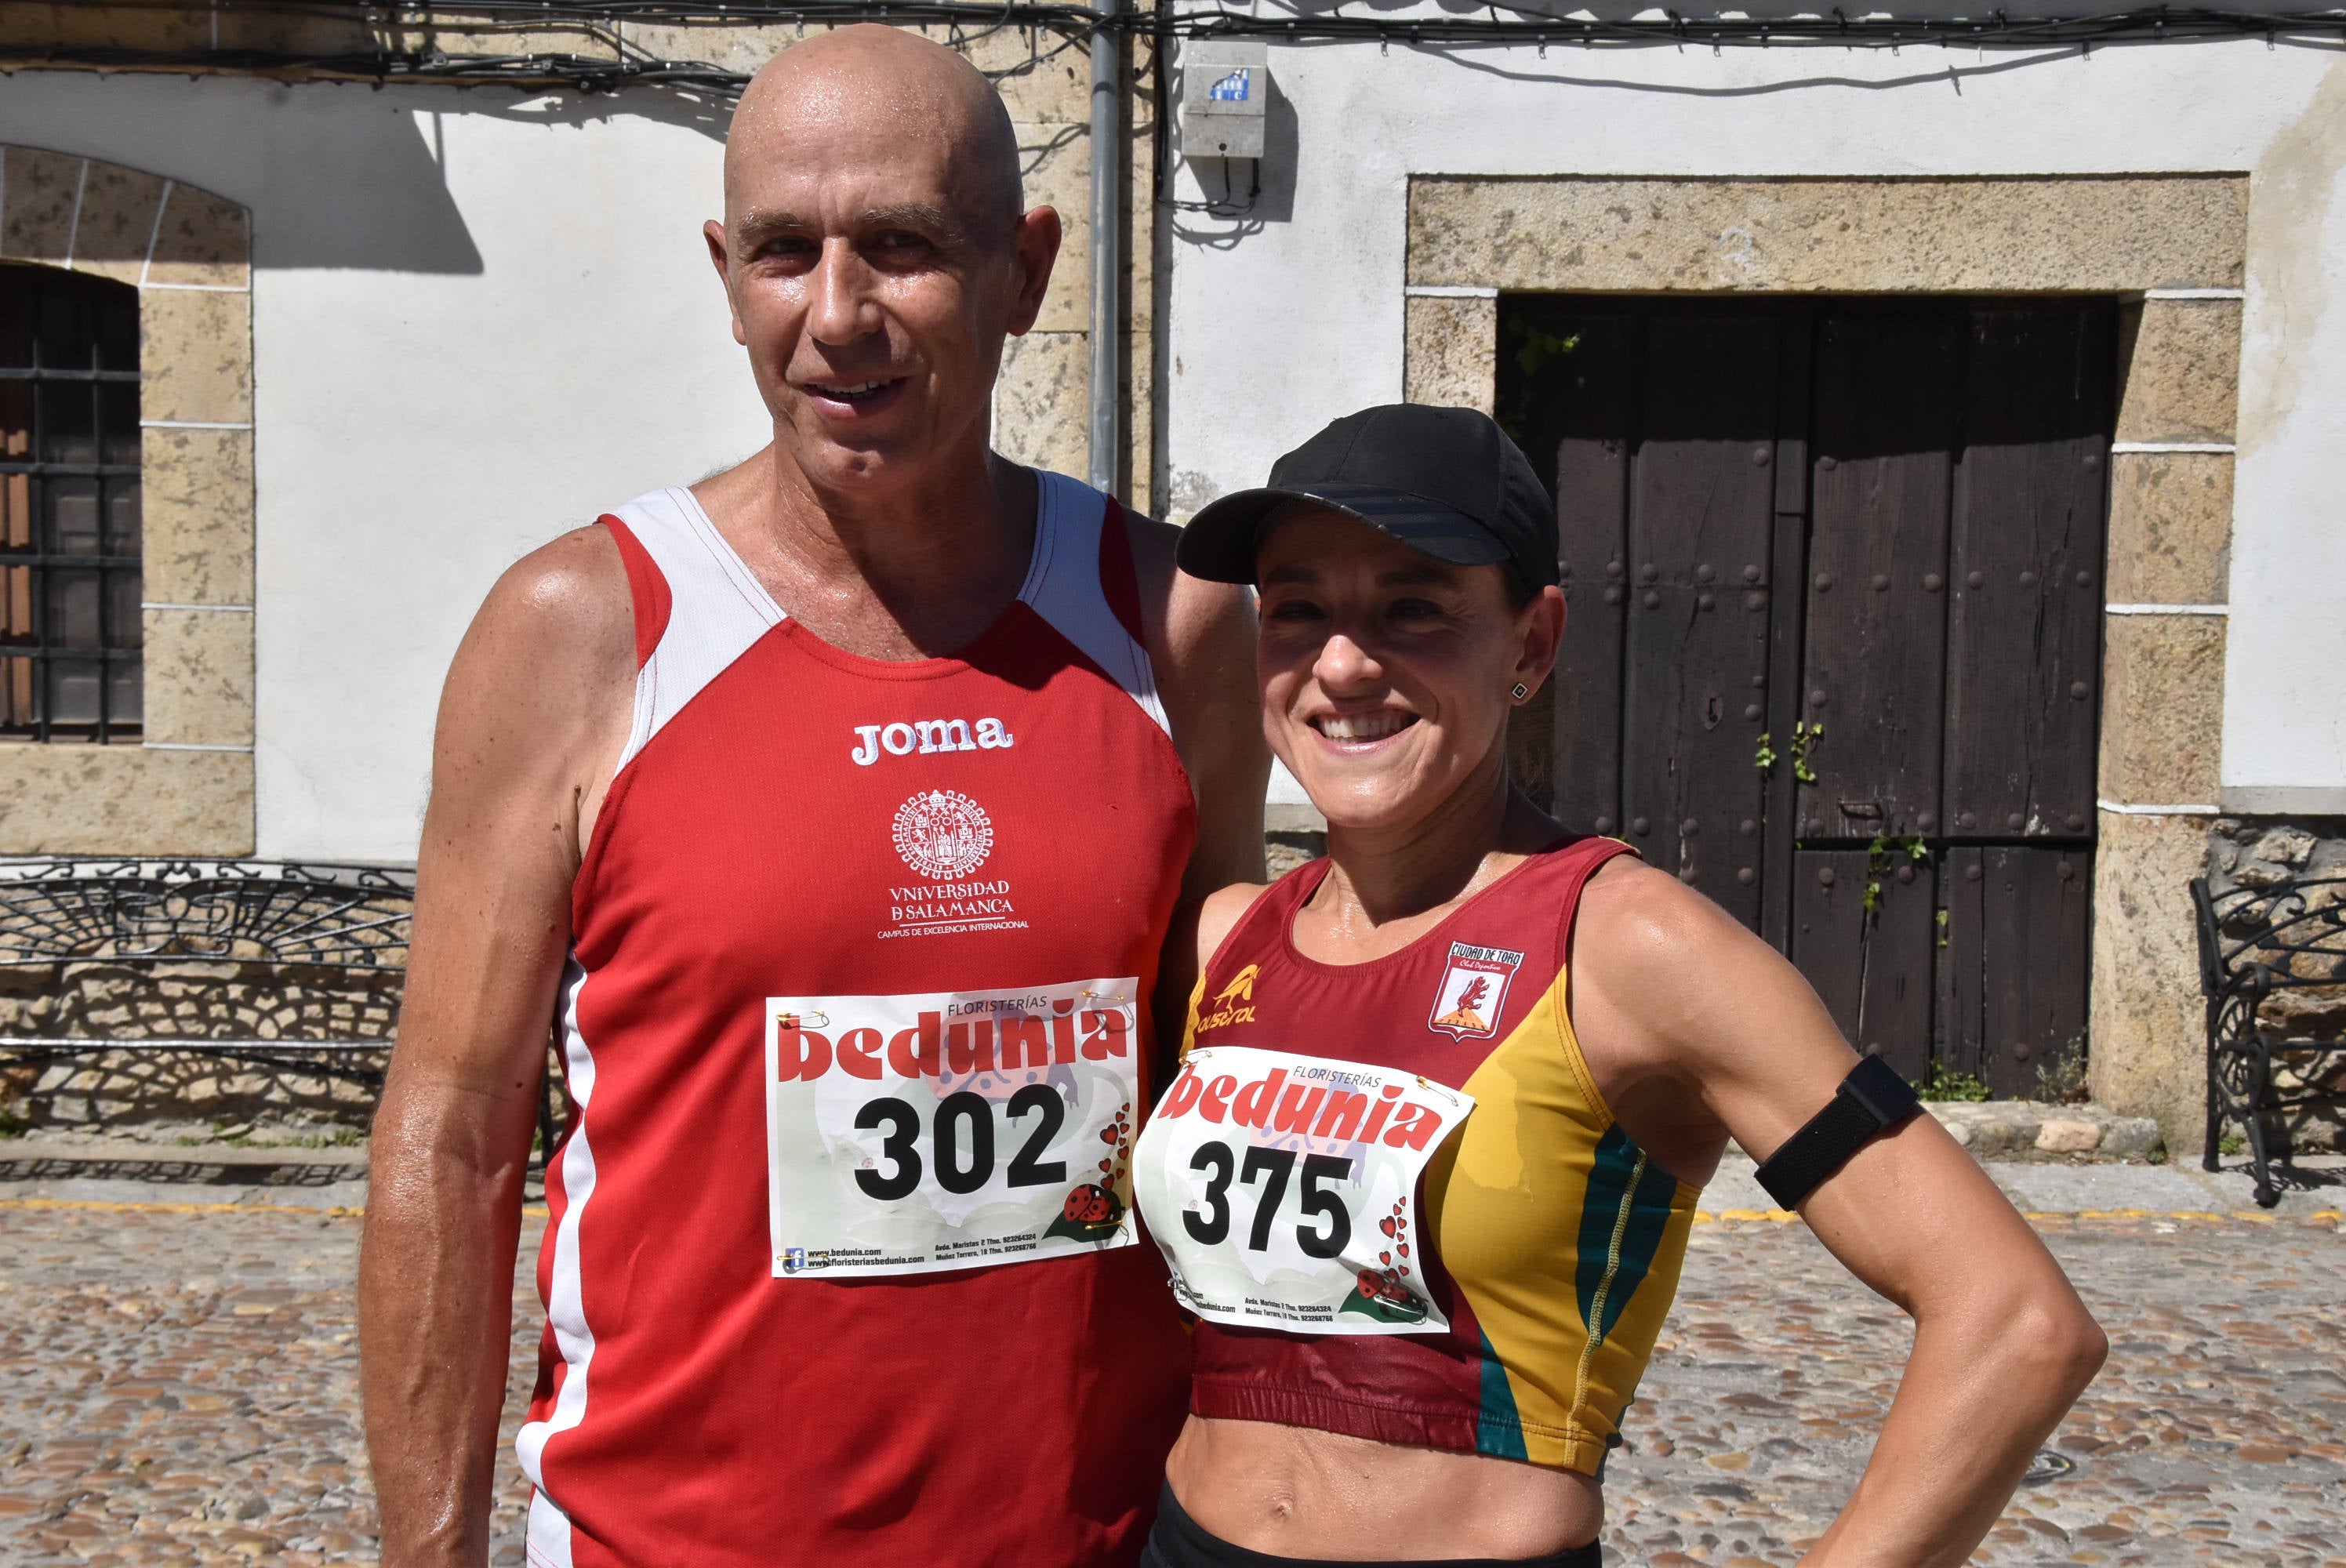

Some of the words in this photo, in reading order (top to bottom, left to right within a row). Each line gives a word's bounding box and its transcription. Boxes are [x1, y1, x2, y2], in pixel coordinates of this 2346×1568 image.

[852, 717, 1014, 766] Joma
[906, 898, 1015, 920] SALAMANCA
[877, 928, 910, 939] CAMPUS
[911, 927, 922, 937] DE
[924, 924, 968, 936] EXCELENCIA
[969, 920, 1030, 932] INTERNACIONAL
[1451, 943, 1484, 960] CIUDAD
[1484, 949, 1496, 961] DE
[1496, 950, 1521, 965] TORO
[947, 995, 1048, 1017] FLORISTERÍAS
[778, 998, 1128, 1083] bedunia
[1292, 1065, 1382, 1088] FLORISTERÍAS
[1157, 1064, 1443, 1152] bedunia
[853, 1083, 1067, 1201] 302
[1182, 1140, 1355, 1259] 375
[935, 1243, 951, 1252] Avda.
[952, 1240, 979, 1250] Maristas
[1244, 1297, 1259, 1305] Avda.
[1259, 1298, 1280, 1308] Maristas
